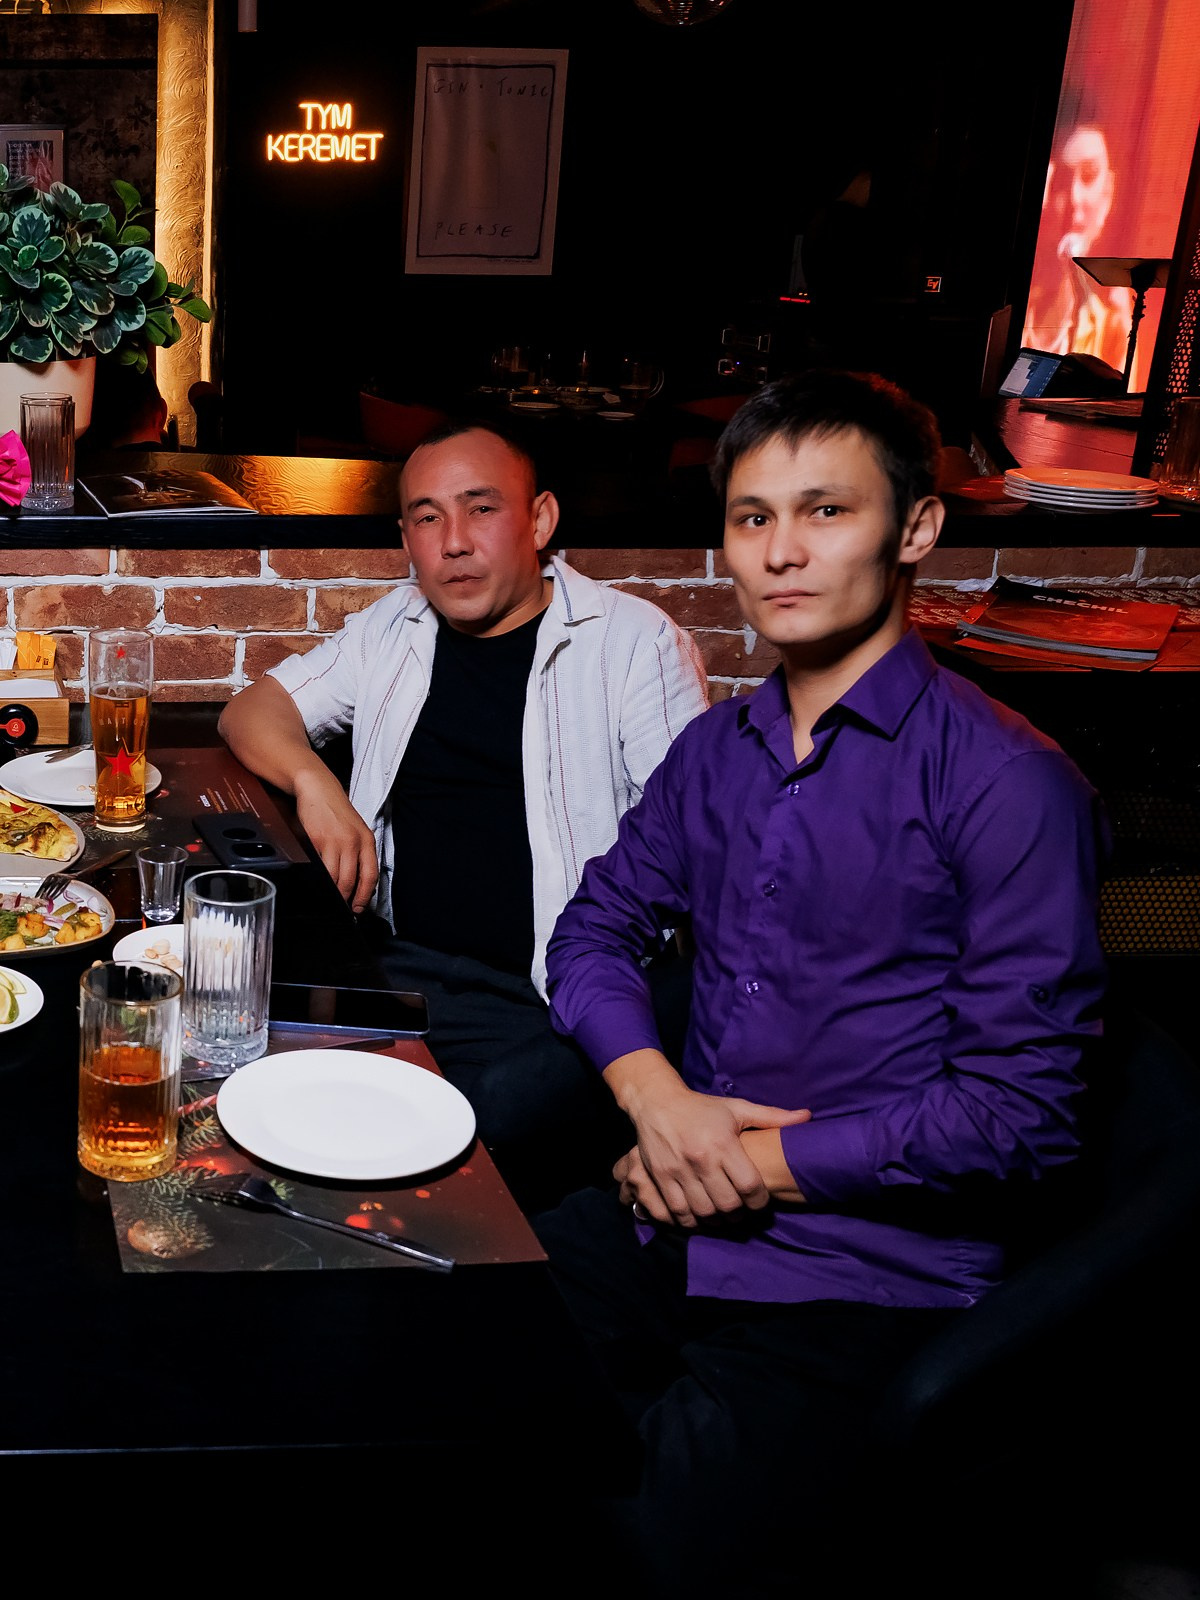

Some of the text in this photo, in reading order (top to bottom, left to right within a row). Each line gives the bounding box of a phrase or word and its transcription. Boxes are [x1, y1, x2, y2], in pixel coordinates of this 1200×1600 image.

[433, 76, 550, 97] GIN TONIC
[298, 102, 352, 130] TYM
[266, 132, 384, 162] KEREMET
[434, 222, 514, 240] PLEASE
